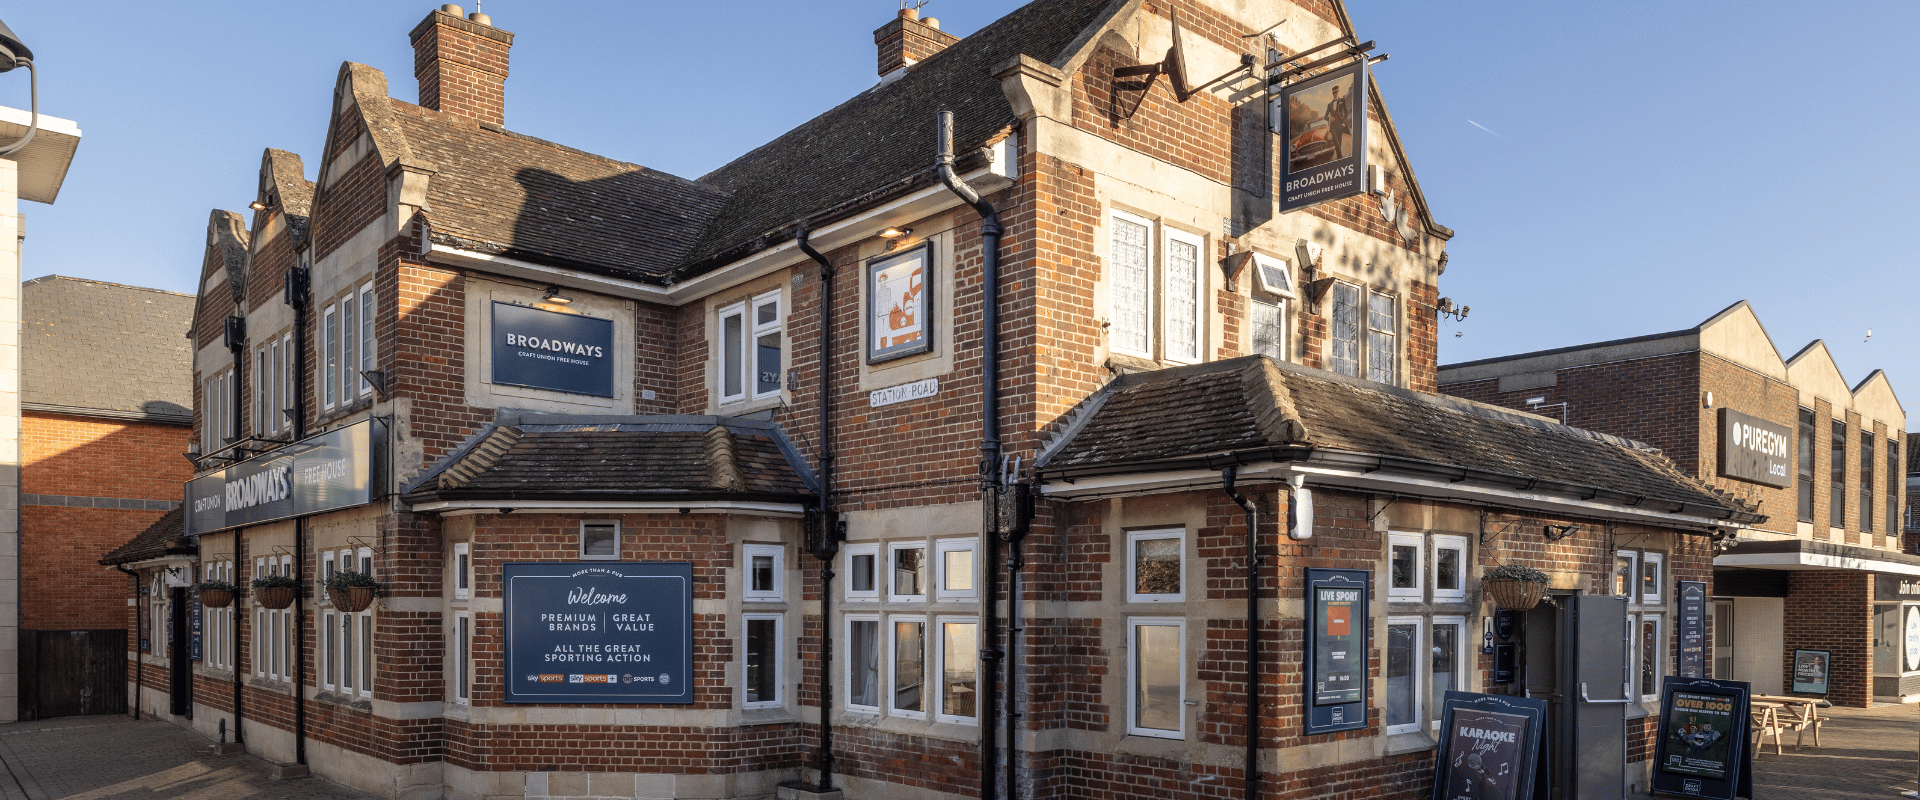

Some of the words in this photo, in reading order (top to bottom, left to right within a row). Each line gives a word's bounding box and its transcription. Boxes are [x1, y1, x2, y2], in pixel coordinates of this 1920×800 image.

[1286, 164, 1354, 192] BROADWAYS
[1287, 193, 1303, 202] CRAFT
[1303, 189, 1321, 198] UNION
[1321, 186, 1334, 194] FREE
[1334, 180, 1353, 190] HOUSE
[506, 333, 603, 358] BROADWAYS
[536, 353, 555, 361] UNION
[570, 358, 590, 366] HOUSE
[872, 386, 908, 405] STATION
[911, 381, 936, 397] ROAD
[1743, 424, 1786, 458] PUREGYM
[304, 466, 320, 485] FREE
[321, 458, 346, 480] HOUSE
[1770, 460, 1786, 476] Local
[225, 466, 290, 512] BROADWAYS
[194, 497, 207, 513] CRAFT
[207, 493, 221, 509] UNION
[572, 569, 588, 578] MORE
[611, 570, 623, 578] PUB
[1899, 579, 1910, 595] Join
[567, 586, 628, 605] Welcome
[1320, 590, 1335, 601] LIVE
[1336, 591, 1358, 601] SPORT
[541, 613, 596, 622] PREMIUM
[612, 613, 651, 622] GREAT
[549, 623, 596, 632] BRANDS
[616, 623, 654, 632] VALUE
[554, 644, 574, 653] ALL
[578, 644, 600, 653] THE
[604, 644, 641, 653] GREAT
[544, 654, 603, 662] SPORTING
[607, 654, 651, 662] ACTION
[527, 674, 539, 682] sky
[540, 674, 563, 683] sports
[570, 674, 583, 683] sky
[584, 675, 607, 683] sports
[1676, 698, 1703, 709] OVER
[1705, 701, 1732, 712] 1000
[1460, 726, 1516, 743] KARAOKE
[1471, 738, 1501, 756] Night
